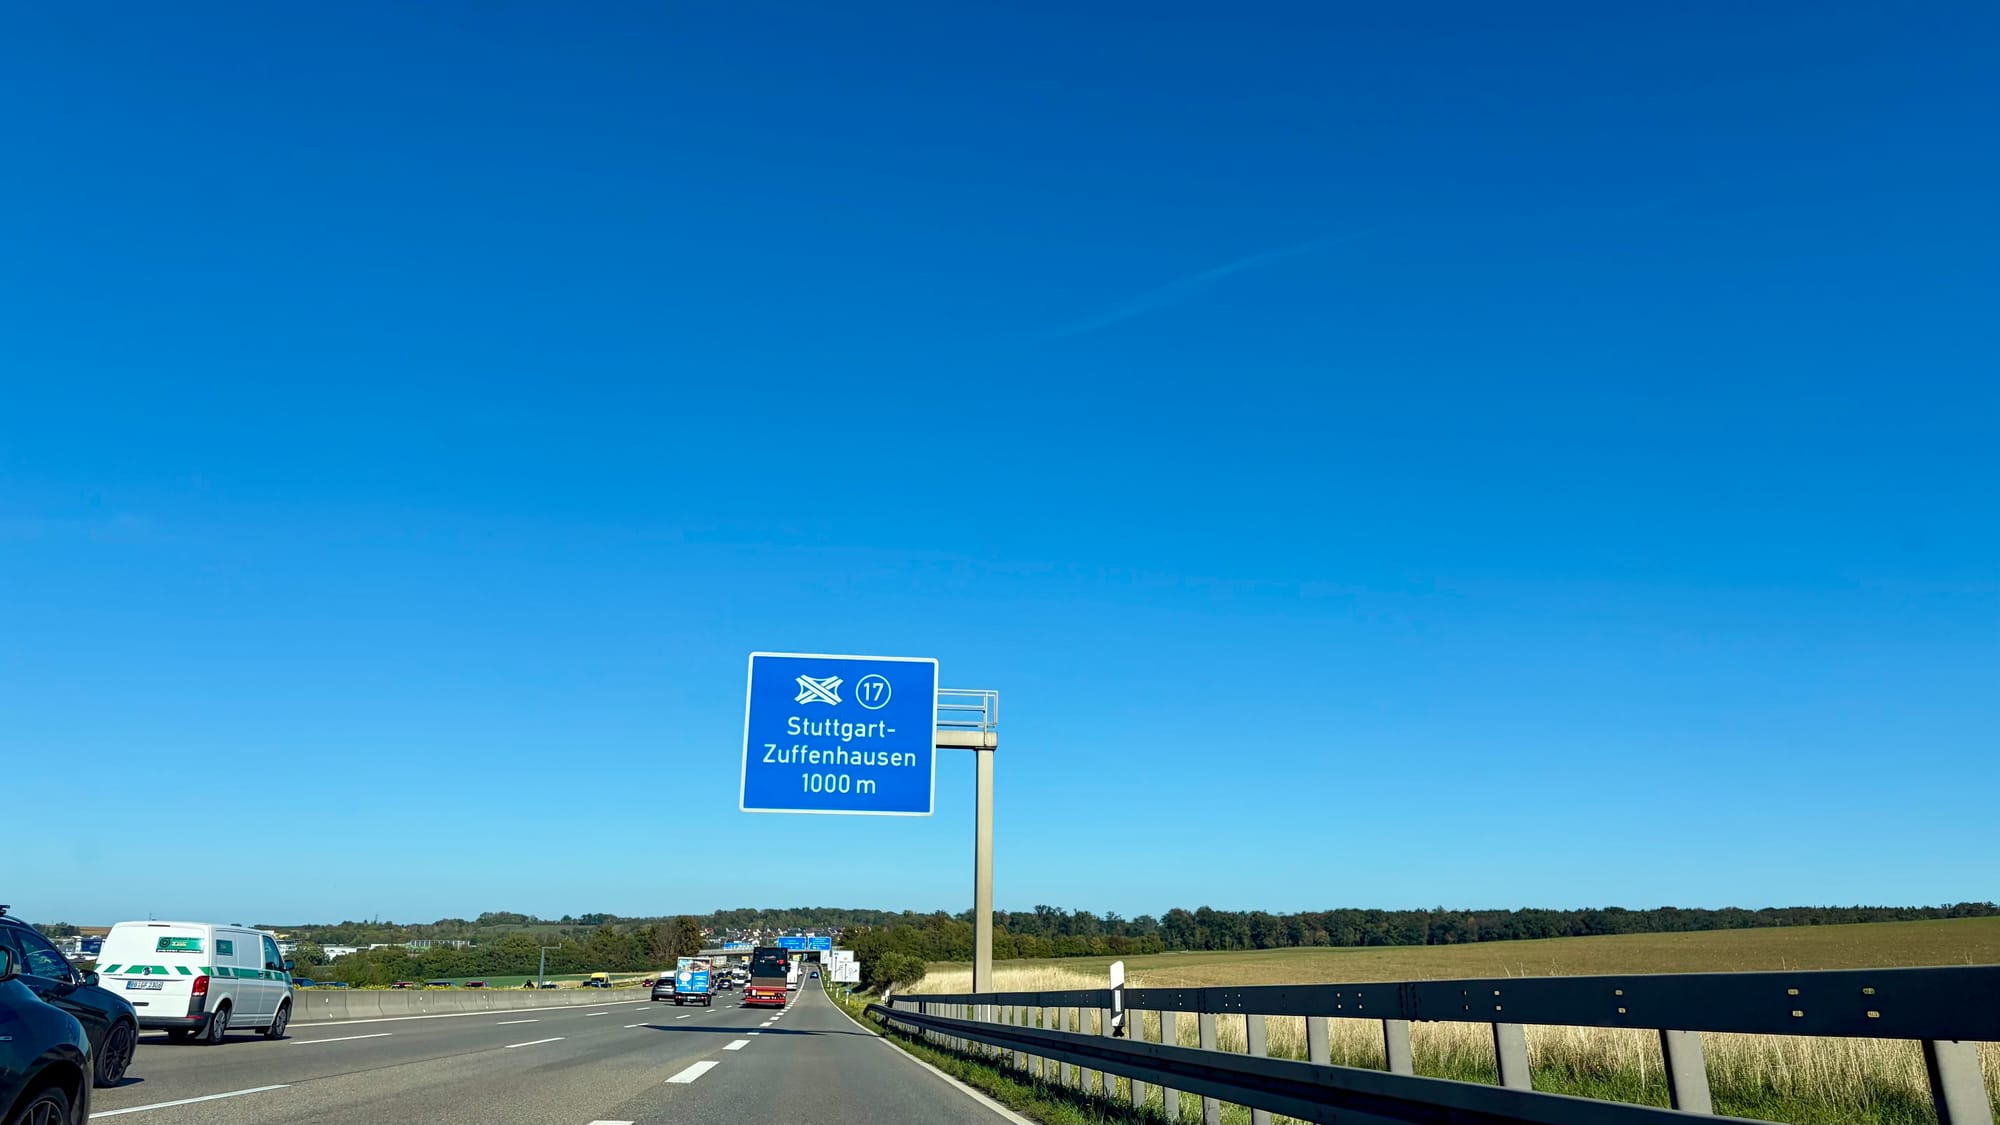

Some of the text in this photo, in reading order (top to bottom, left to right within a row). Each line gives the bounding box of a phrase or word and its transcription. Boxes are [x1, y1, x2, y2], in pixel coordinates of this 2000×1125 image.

[864, 682, 884, 701] 17
[787, 716, 896, 742] Stuttgart-
[763, 744, 916, 767] Zuffenhausen
[802, 773, 876, 794] 1000 m
